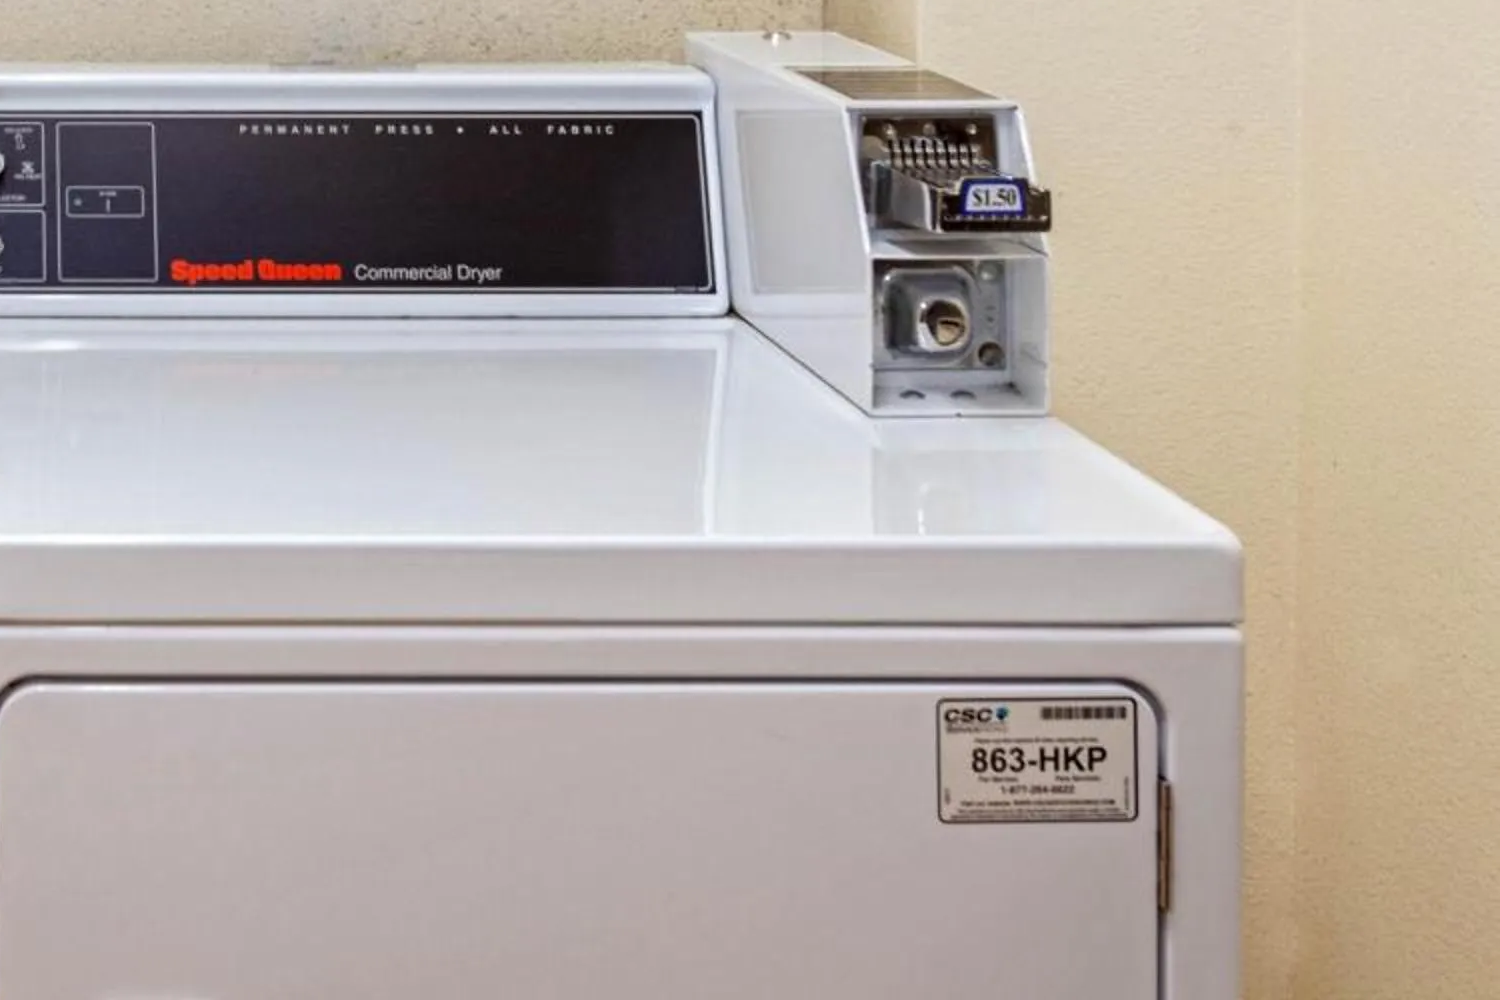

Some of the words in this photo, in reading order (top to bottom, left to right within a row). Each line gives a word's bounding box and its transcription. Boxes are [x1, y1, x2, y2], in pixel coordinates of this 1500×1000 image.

[239, 124, 351, 135] PERMANENT
[375, 124, 435, 135] PRESS
[489, 124, 523, 135] ALL
[547, 124, 615, 135] FABRIC
[972, 187, 1017, 207] $1.50
[171, 259, 254, 286] Speed
[257, 259, 342, 282] Queen
[354, 264, 452, 281] Commercial
[456, 264, 503, 284] Dryer
[944, 707, 994, 723] CSC
[971, 747, 1108, 773] 863-HKP
